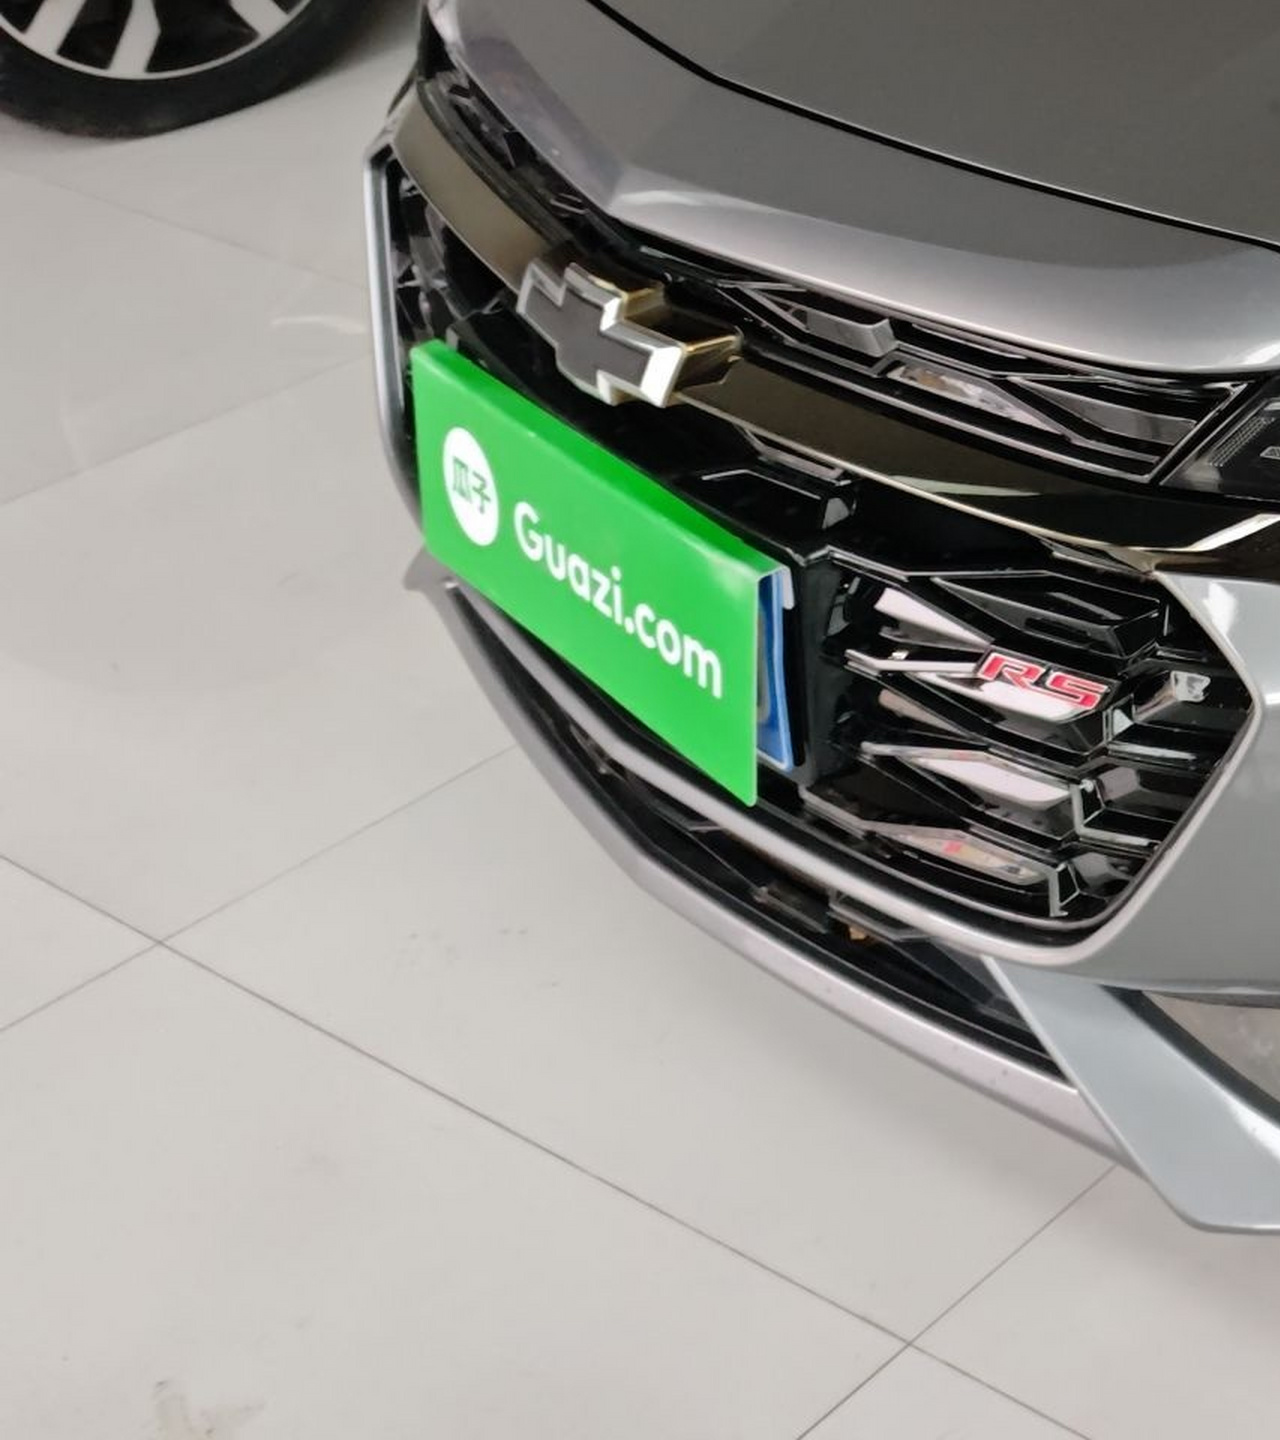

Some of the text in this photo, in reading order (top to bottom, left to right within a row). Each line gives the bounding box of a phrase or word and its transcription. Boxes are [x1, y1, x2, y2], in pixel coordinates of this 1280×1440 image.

[452, 456, 491, 514] 瓜子
[513, 501, 723, 699] Guazi.com
[978, 652, 1108, 709] RS
